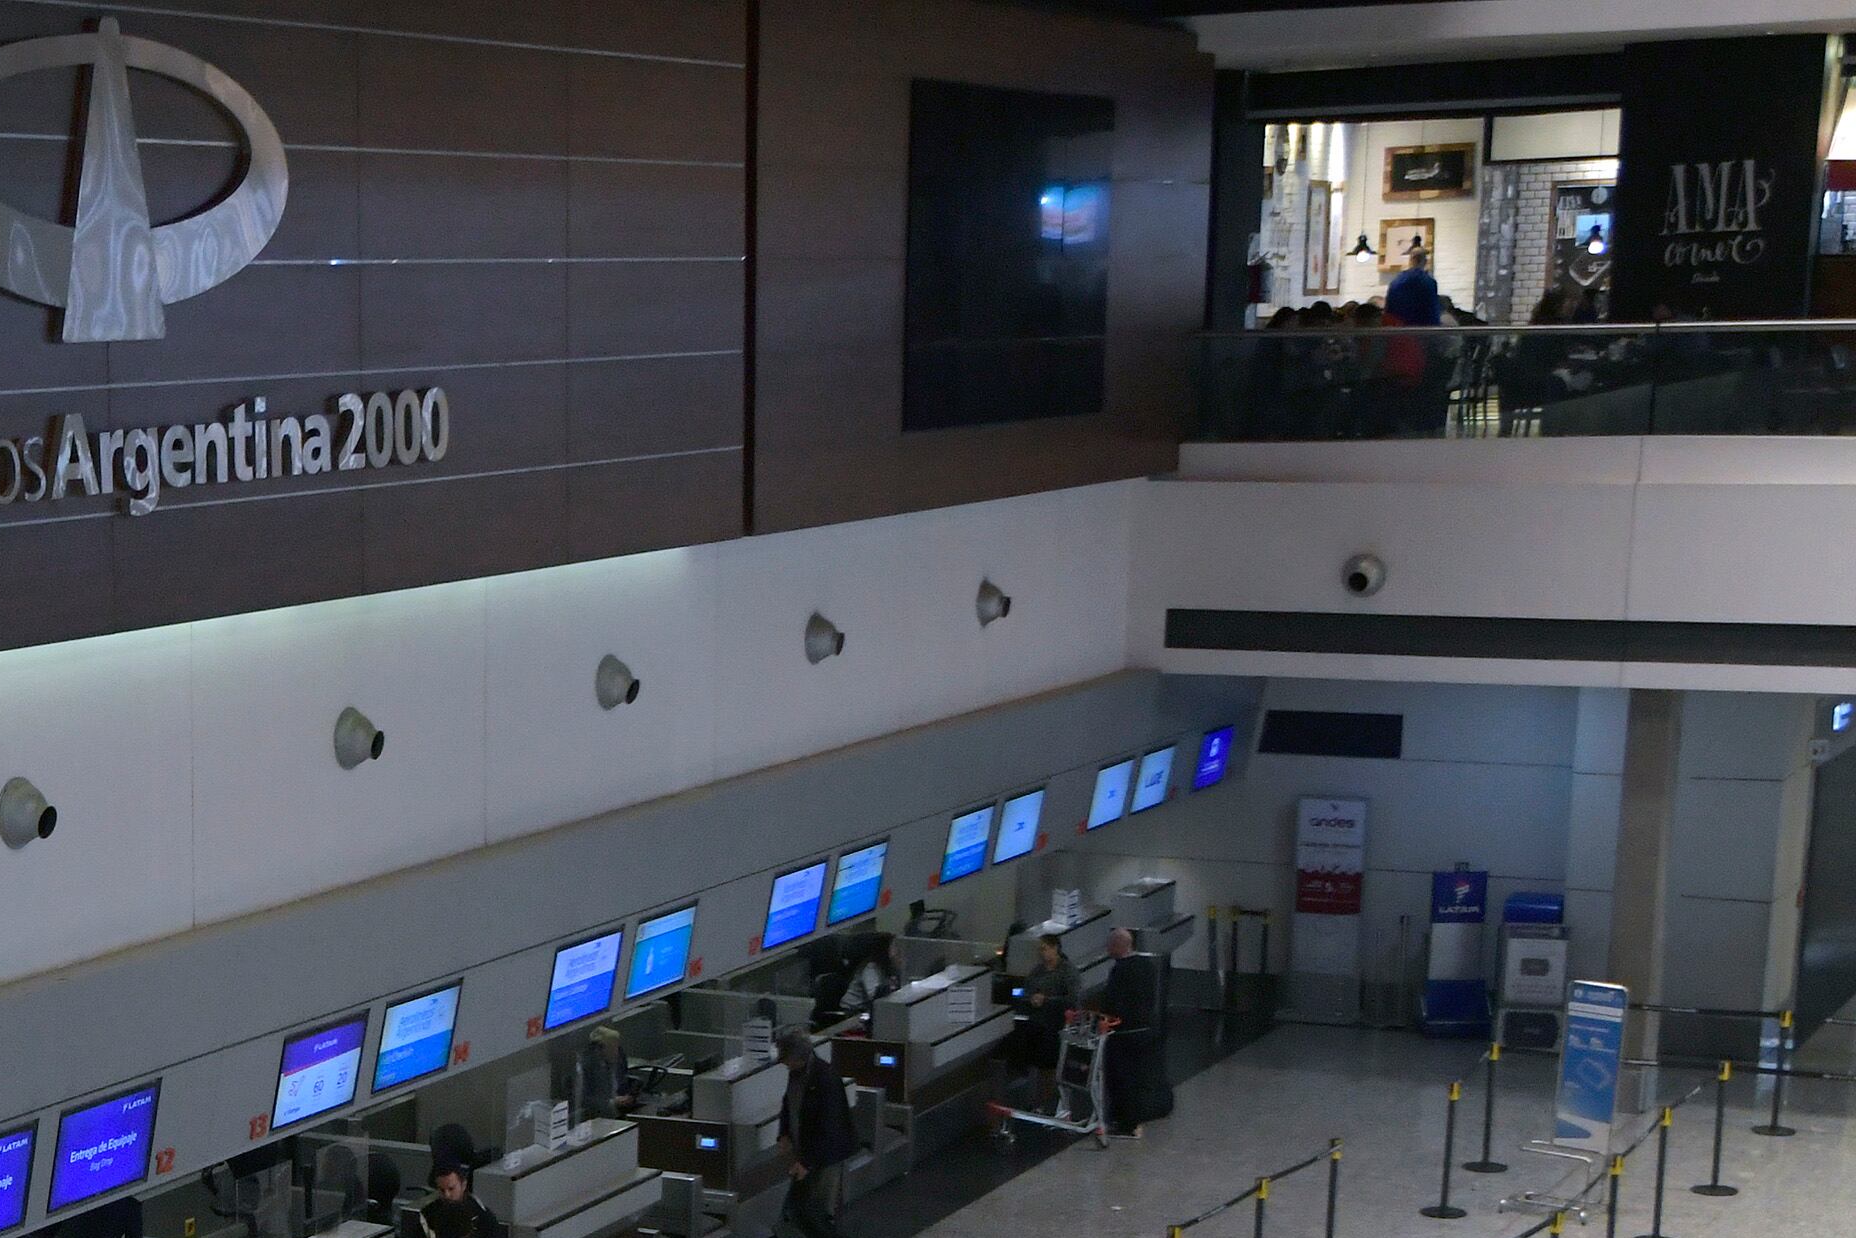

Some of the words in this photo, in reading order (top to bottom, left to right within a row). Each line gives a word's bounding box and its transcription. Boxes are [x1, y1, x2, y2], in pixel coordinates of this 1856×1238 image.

[128, 1095, 152, 1111] LATAM
[248, 1112, 269, 1141] 13
[2, 1137, 29, 1153] LATAM
[69, 1145, 98, 1164] Entrega
[98, 1142, 108, 1156] de
[107, 1131, 138, 1152] Equipaje
[89, 1159, 100, 1172] Bag
[155, 1147, 177, 1176] 12
